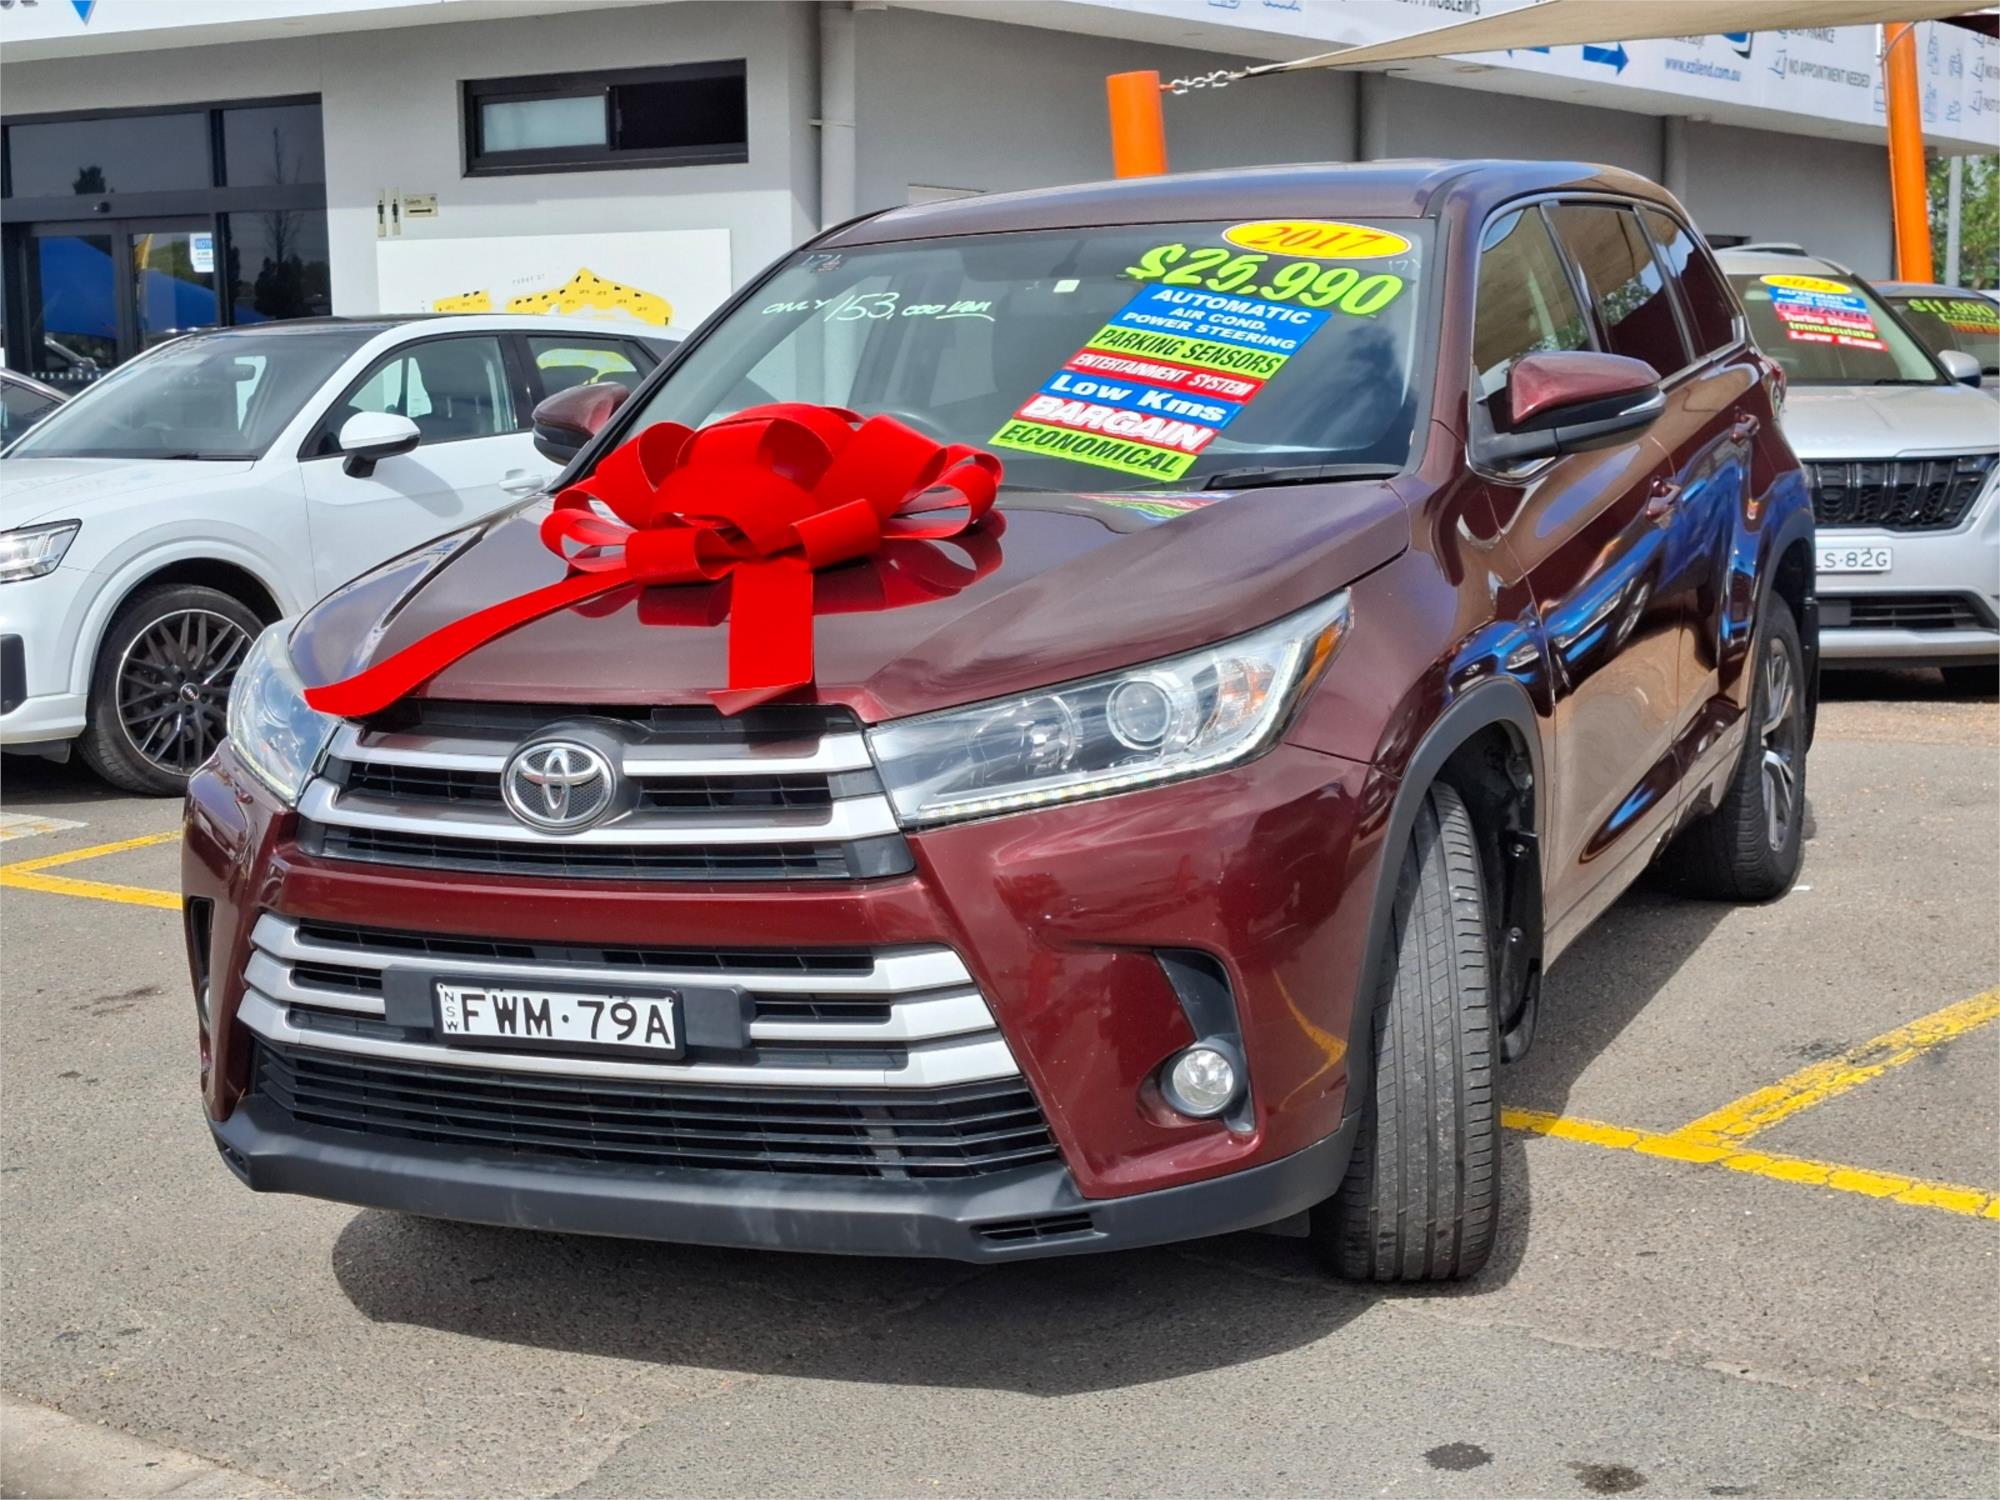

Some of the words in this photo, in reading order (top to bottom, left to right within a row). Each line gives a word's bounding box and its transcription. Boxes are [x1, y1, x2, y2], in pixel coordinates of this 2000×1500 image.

[1800, 61, 1846, 84] APPOINTMENT
[1246, 226, 1386, 252] 2017
[1152, 289, 1312, 324] AUTOMATIC
[1169, 307, 1206, 321] AIR
[1208, 313, 1268, 331] COND.
[1783, 312, 1825, 324] Turbo
[1122, 312, 1193, 331] POWER
[1195, 323, 1297, 349] STEERING
[1094, 328, 1184, 357] PARKING
[1181, 343, 1282, 373] SENSORS
[1072, 353, 1192, 383] ENTERTAINMENT
[1188, 373, 1256, 397] SYSTEM
[1020, 396, 1214, 451] BARGAIN
[1137, 390, 1228, 422] Kms
[1000, 424, 1182, 473] ECONOMICAL
